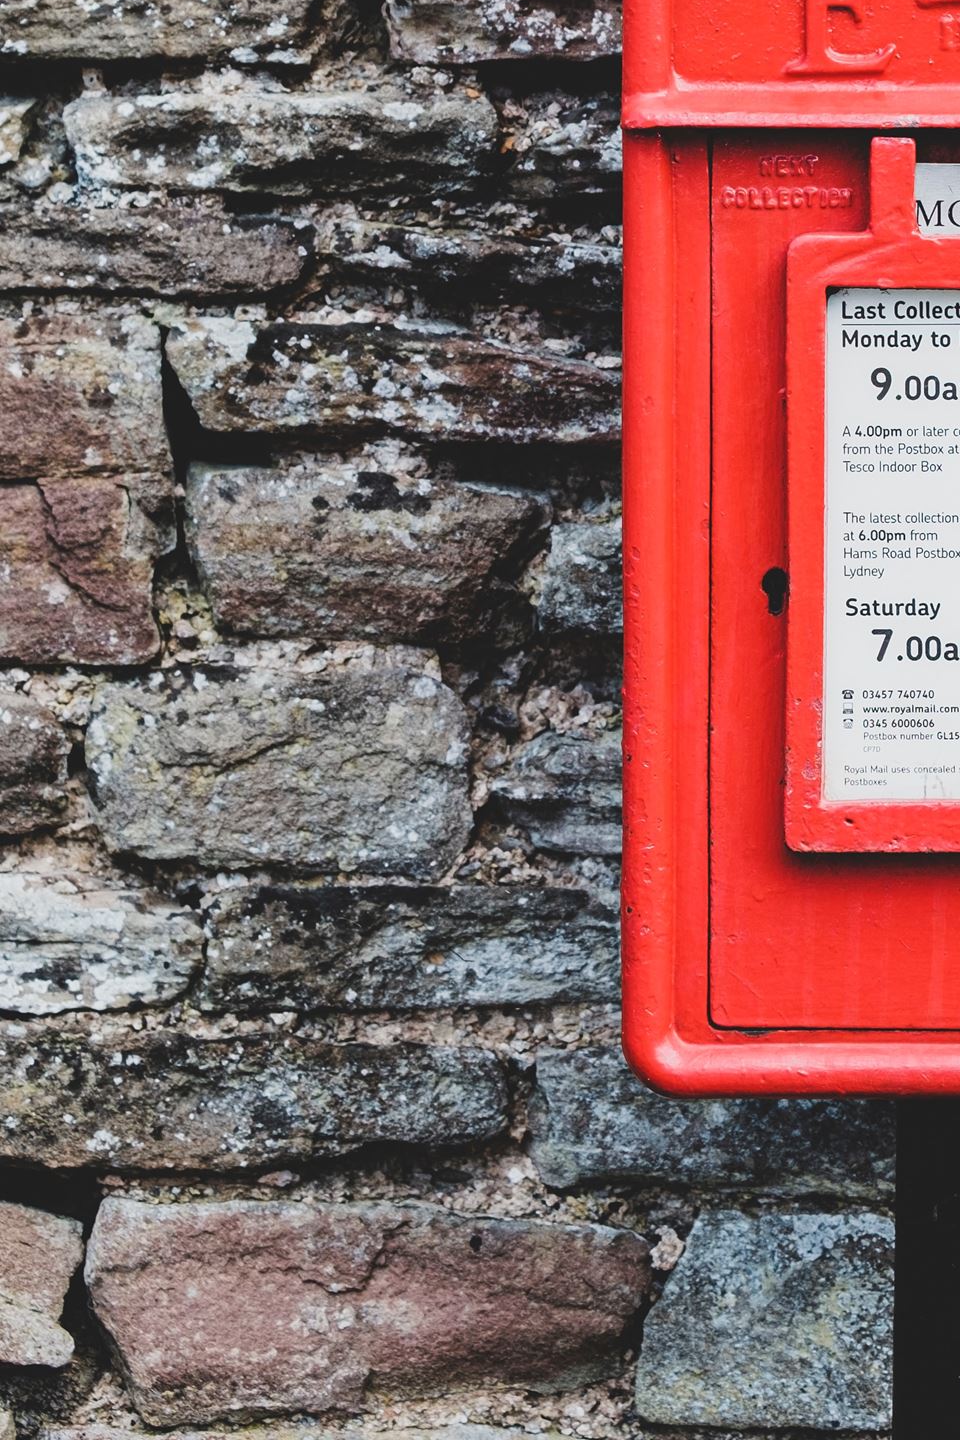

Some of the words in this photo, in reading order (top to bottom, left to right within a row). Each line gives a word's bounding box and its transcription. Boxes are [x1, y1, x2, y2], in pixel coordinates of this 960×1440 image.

[759, 153, 819, 178] NEXT
[720, 185, 855, 211] COLLECTION
[842, 301, 886, 319] Last
[842, 330, 923, 352] Monday
[931, 331, 951, 347] to
[843, 425, 851, 437] A
[855, 425, 902, 439] 4.00pm
[907, 428, 919, 437] or
[923, 426, 949, 437] later
[843, 443, 870, 454] from
[875, 443, 894, 455] the
[898, 443, 944, 454] Postbox
[948, 444, 959, 454] at
[843, 461, 875, 472] Tesco
[879, 461, 917, 472] Indoor
[921, 461, 942, 472] Box
[843, 512, 865, 523] The
[870, 512, 901, 524] latest
[905, 512, 959, 523] collection
[843, 531, 855, 541] at
[859, 530, 906, 543] 6.00pm
[910, 529, 938, 541] from
[844, 548, 877, 559] Hams
[882, 547, 911, 559] Road
[844, 565, 884, 579] Lydney
[846, 598, 940, 620] Saturday
[863, 690, 893, 699] 03457
[897, 690, 934, 699] 740740
[863, 704, 959, 715] www.royalmail.com
[863, 719, 887, 728] 0345
[891, 719, 935, 728] 6000606
[864, 732, 897, 740] Postbox
[900, 732, 933, 740] number
[937, 731, 960, 740] GL15
[844, 765, 867, 774] Royal
[871, 765, 888, 773] Mail
[914, 765, 955, 773] concealed
[845, 778, 887, 786] Postboxes
